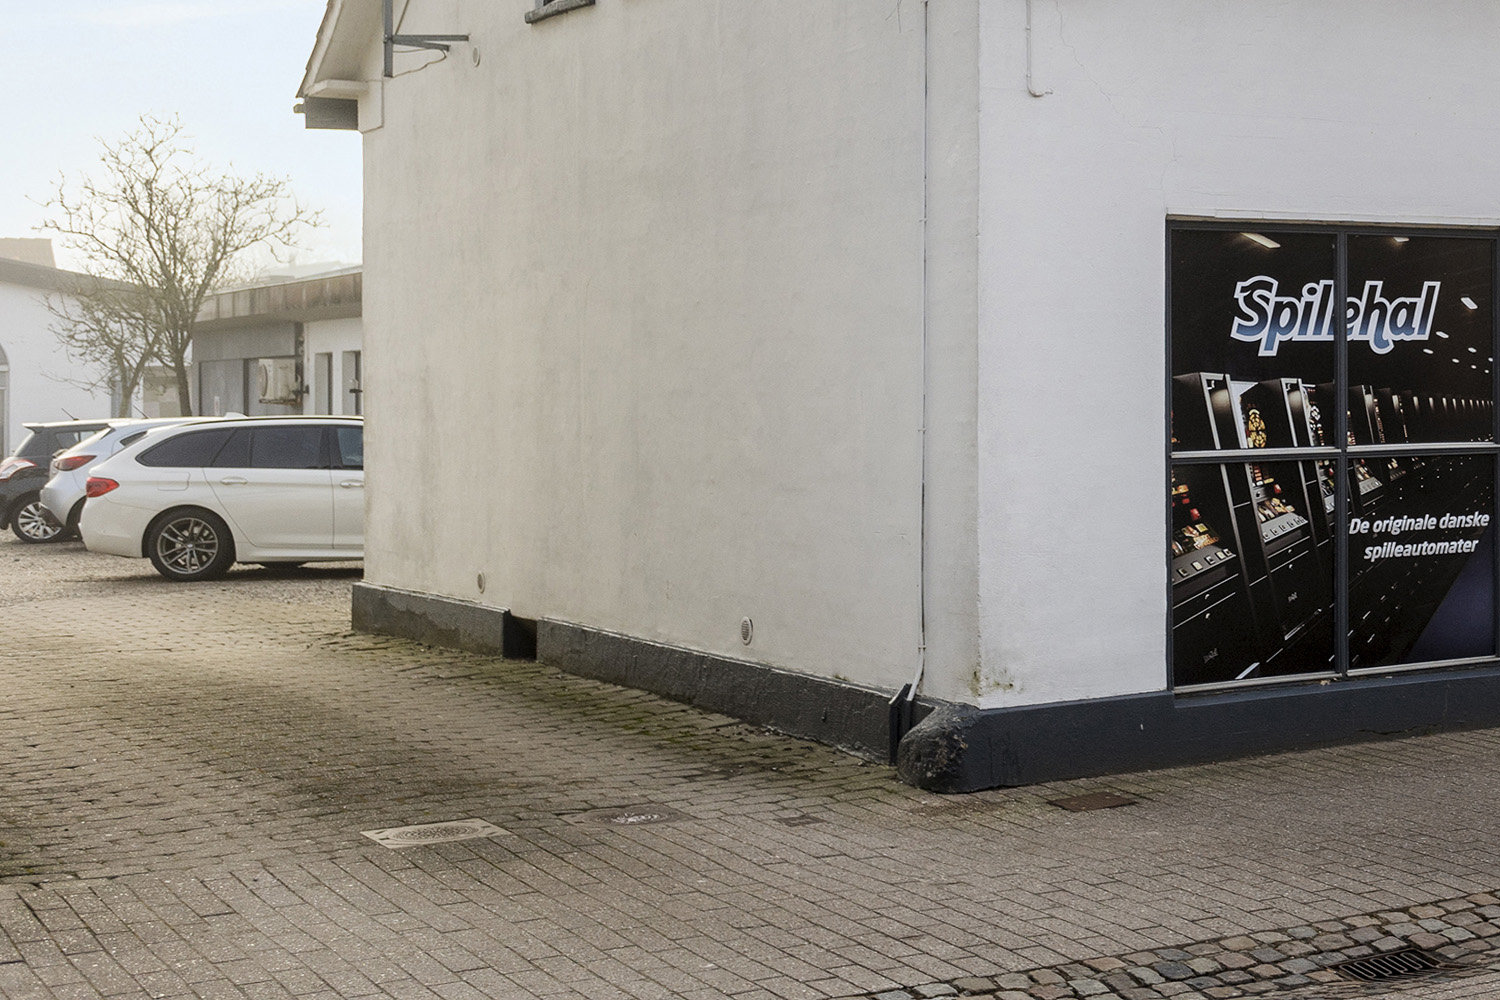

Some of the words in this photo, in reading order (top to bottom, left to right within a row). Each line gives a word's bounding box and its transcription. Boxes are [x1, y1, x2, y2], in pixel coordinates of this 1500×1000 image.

[1230, 275, 1441, 357] Spilehal
[1348, 518, 1370, 535] De
[1372, 513, 1437, 536] originale
[1439, 510, 1490, 529] danske
[1363, 539, 1480, 563] spilleautomater
